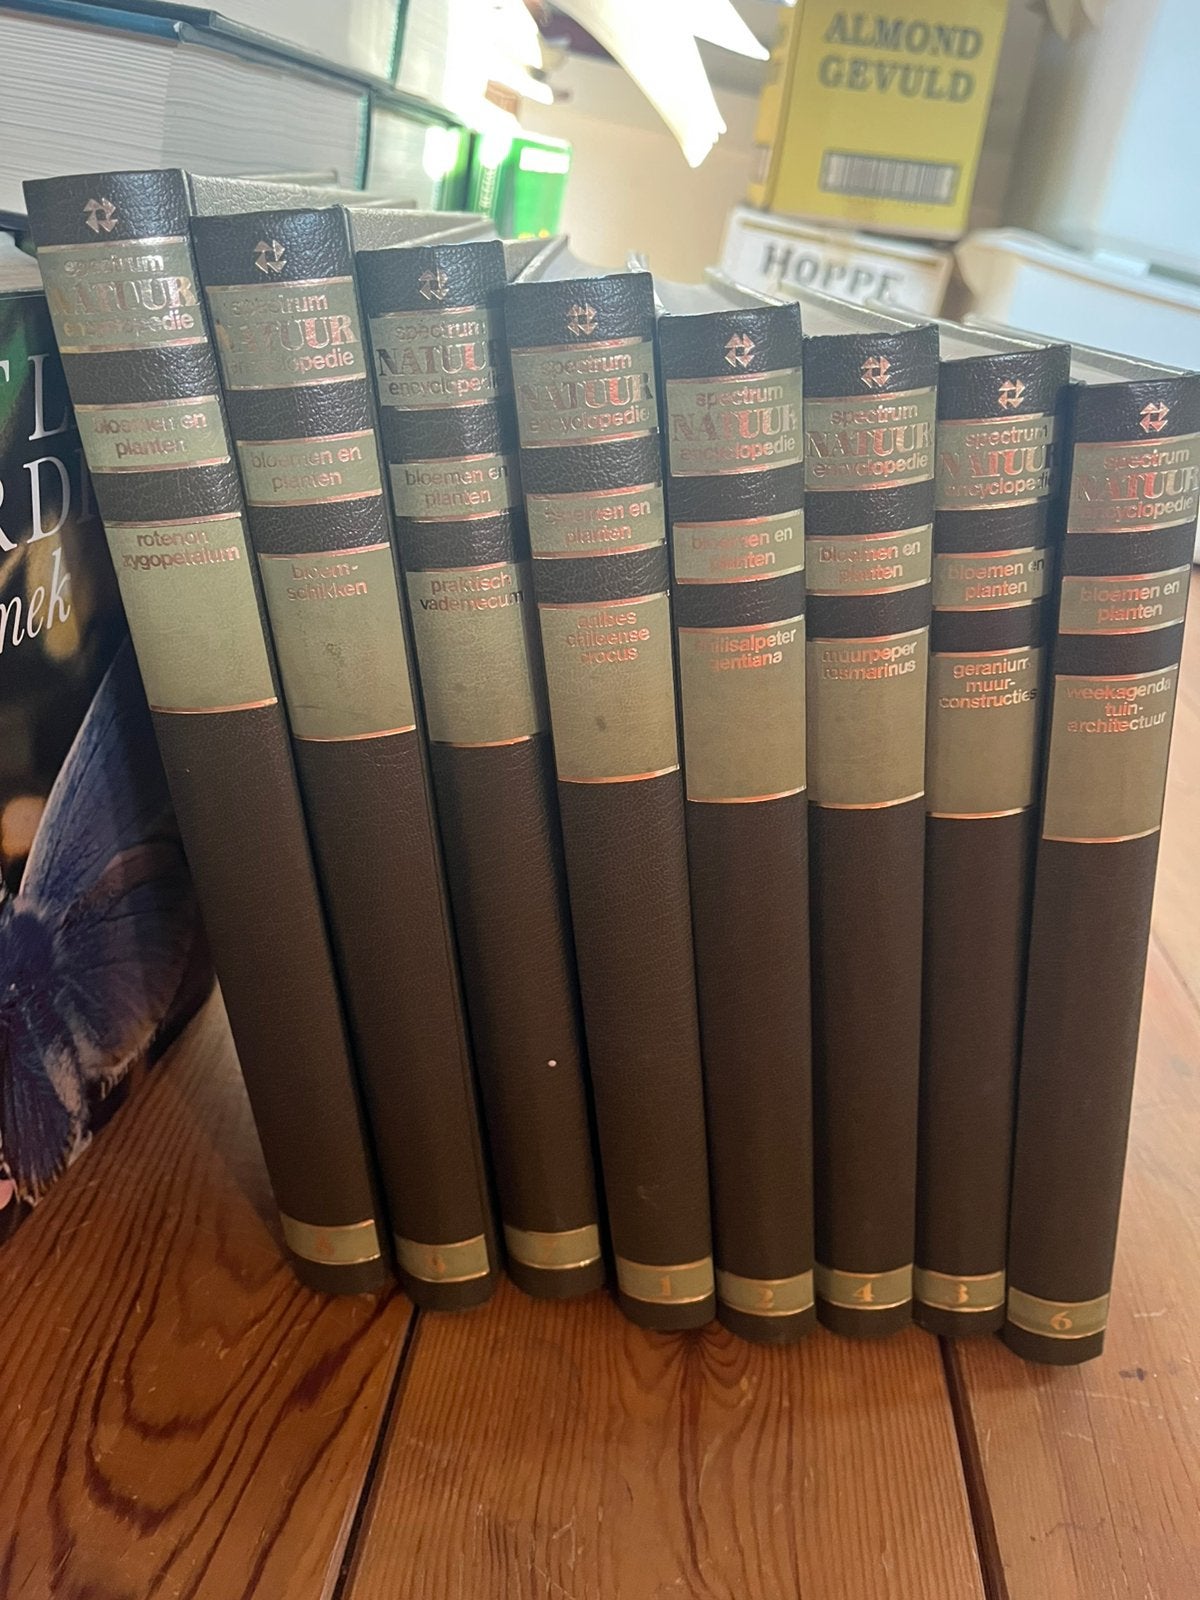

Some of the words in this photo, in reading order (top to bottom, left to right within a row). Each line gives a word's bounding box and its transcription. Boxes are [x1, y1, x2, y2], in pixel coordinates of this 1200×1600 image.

[824, 11, 984, 60] ALMOND
[817, 55, 977, 103] GEVULD
[761, 241, 905, 303] HOPPE
[542, 354, 632, 377] spectrum
[518, 373, 654, 412] NATUUR
[696, 385, 784, 409] spectrum
[179, 411, 208, 430] en
[671, 404, 798, 441] NATUUR
[830, 404, 918, 427] spectrum
[115, 438, 186, 459] planten
[806, 422, 933, 458] NATUUR
[965, 425, 1048, 450] spectrum
[252, 449, 333, 469] bloemen
[336, 446, 363, 463] en
[812, 452, 929, 478] encyclopedie
[1104, 449, 1190, 471] spectrum
[405, 468, 484, 486] bloemen
[488, 465, 508, 480] en
[425, 489, 492, 508] planten
[629, 500, 651, 517] en
[136, 531, 209, 548] rotenon
[565, 525, 632, 546] planten
[774, 527, 793, 543] en
[122, 545, 241, 570] zygopetalum
[902, 541, 921, 556] en
[292, 562, 359, 581] bloem-
[948, 562, 1024, 580] bloemen
[1028, 558, 1045, 573] en
[287, 581, 368, 601] schikken
[431, 572, 512, 595] praktisch
[965, 581, 1027, 601] planten
[1081, 584, 1160, 602] bloemen
[1163, 580, 1181, 596] en
[420, 590, 524, 611] vademecum
[1097, 603, 1163, 624] planten
[710, 650, 783, 673] gentiana
[822, 641, 917, 664] muurpeper
[954, 657, 1031, 679] geranium
[966, 678, 1016, 693] muur-
[1067, 677, 1171, 701] weekagenda
[939, 688, 1037, 709] constructies
[1104, 702, 1144, 717] tuin-
[1067, 711, 1167, 733] architectuur
[659, 1275, 672, 1297] 1
[853, 1283, 875, 1302] 4
[957, 1283, 969, 1304] 3
[756, 1287, 774, 1309] 2
[1051, 1311, 1073, 1331] 6
